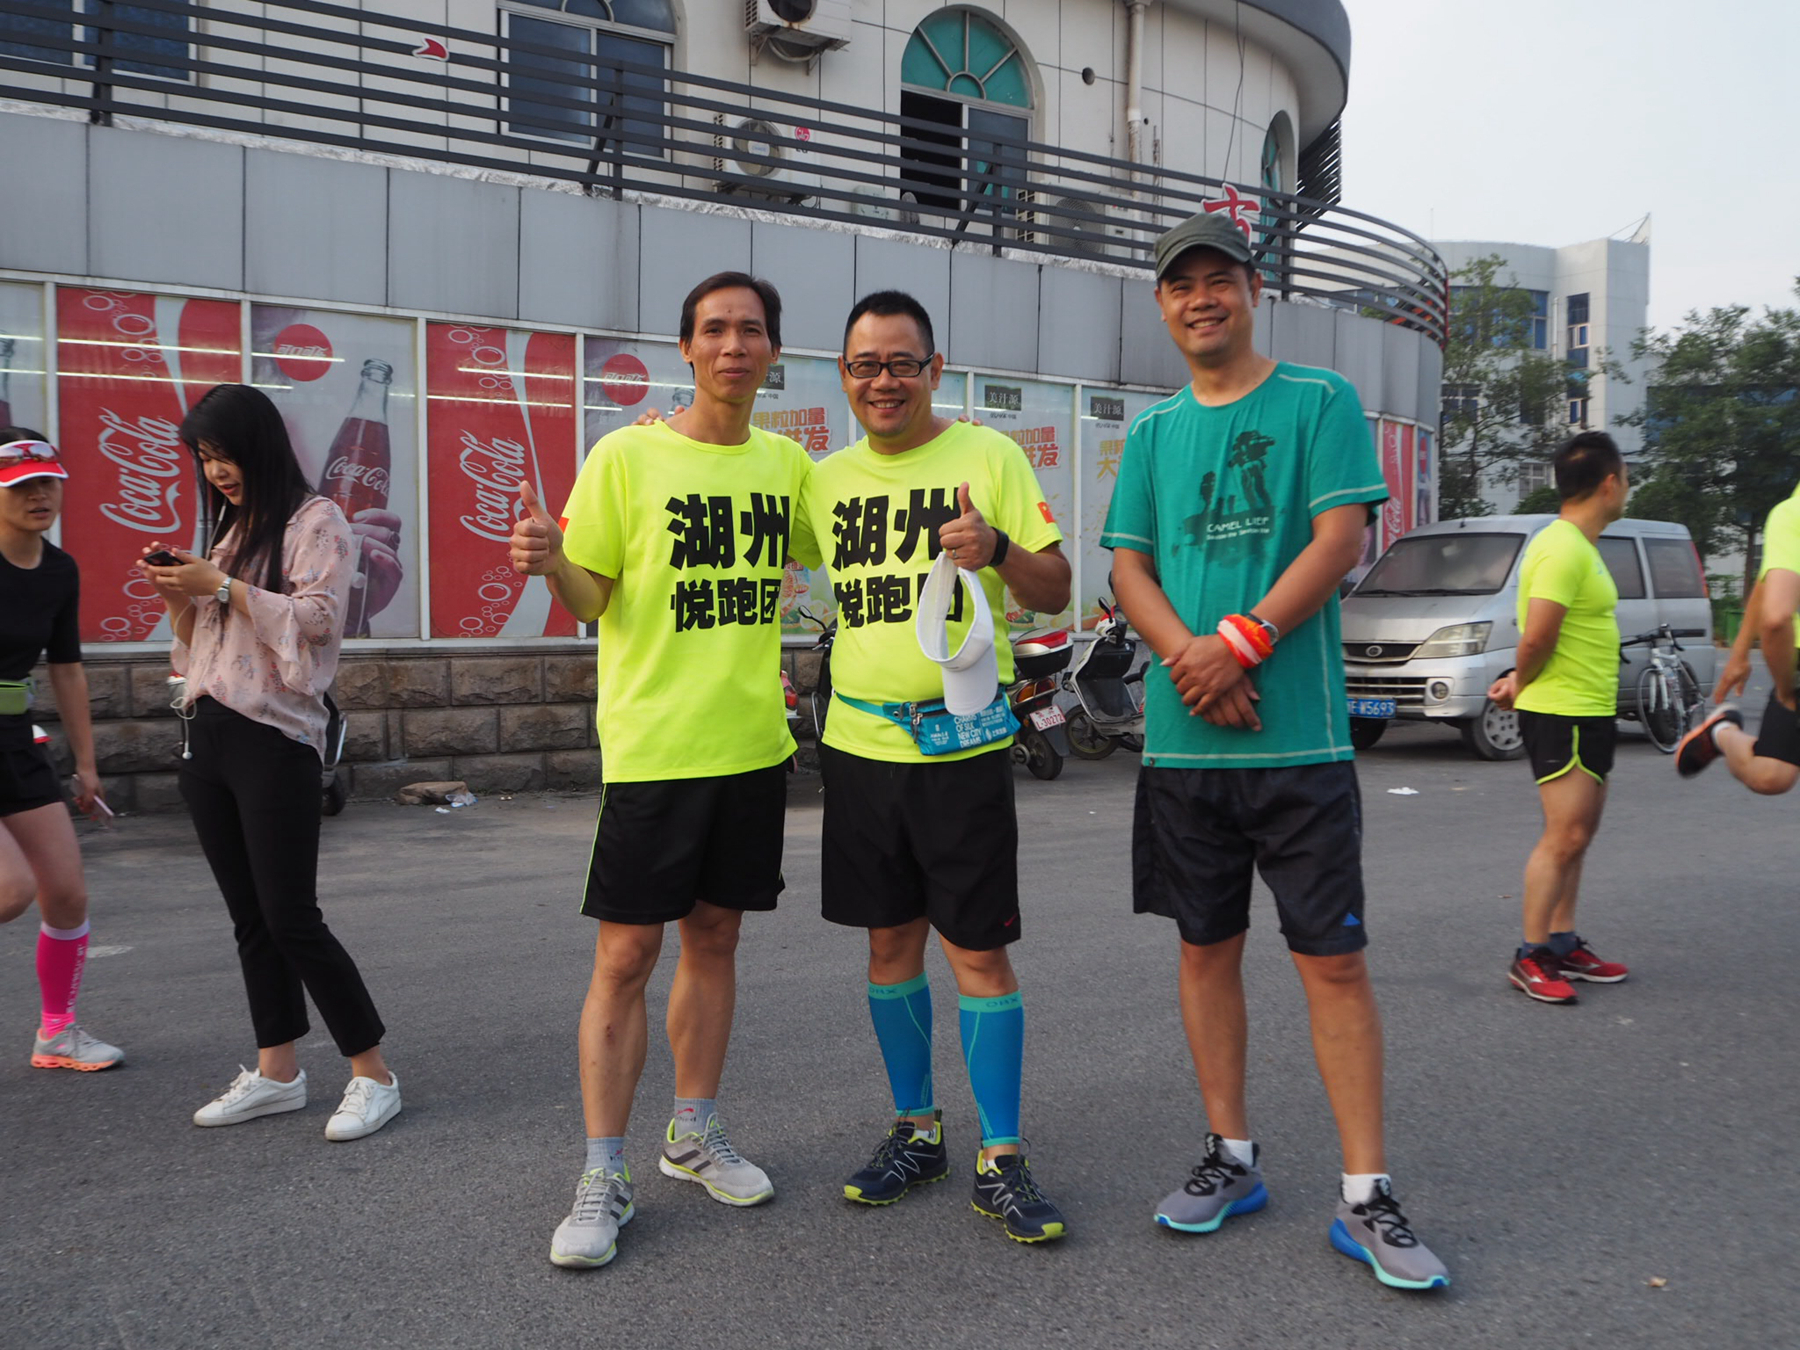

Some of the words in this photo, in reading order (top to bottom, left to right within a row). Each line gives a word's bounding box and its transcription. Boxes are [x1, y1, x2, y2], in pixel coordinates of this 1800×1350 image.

[752, 406, 826, 430] 果粒加量
[989, 391, 1020, 406] 美汁源
[1094, 402, 1124, 417] 美汁源
[98, 407, 181, 533] Coca-Cola
[460, 429, 526, 542] Coca-Cola
[664, 492, 790, 571] 湖州
[831, 487, 962, 572] 湖州
[670, 577, 781, 633] 悦跑团
